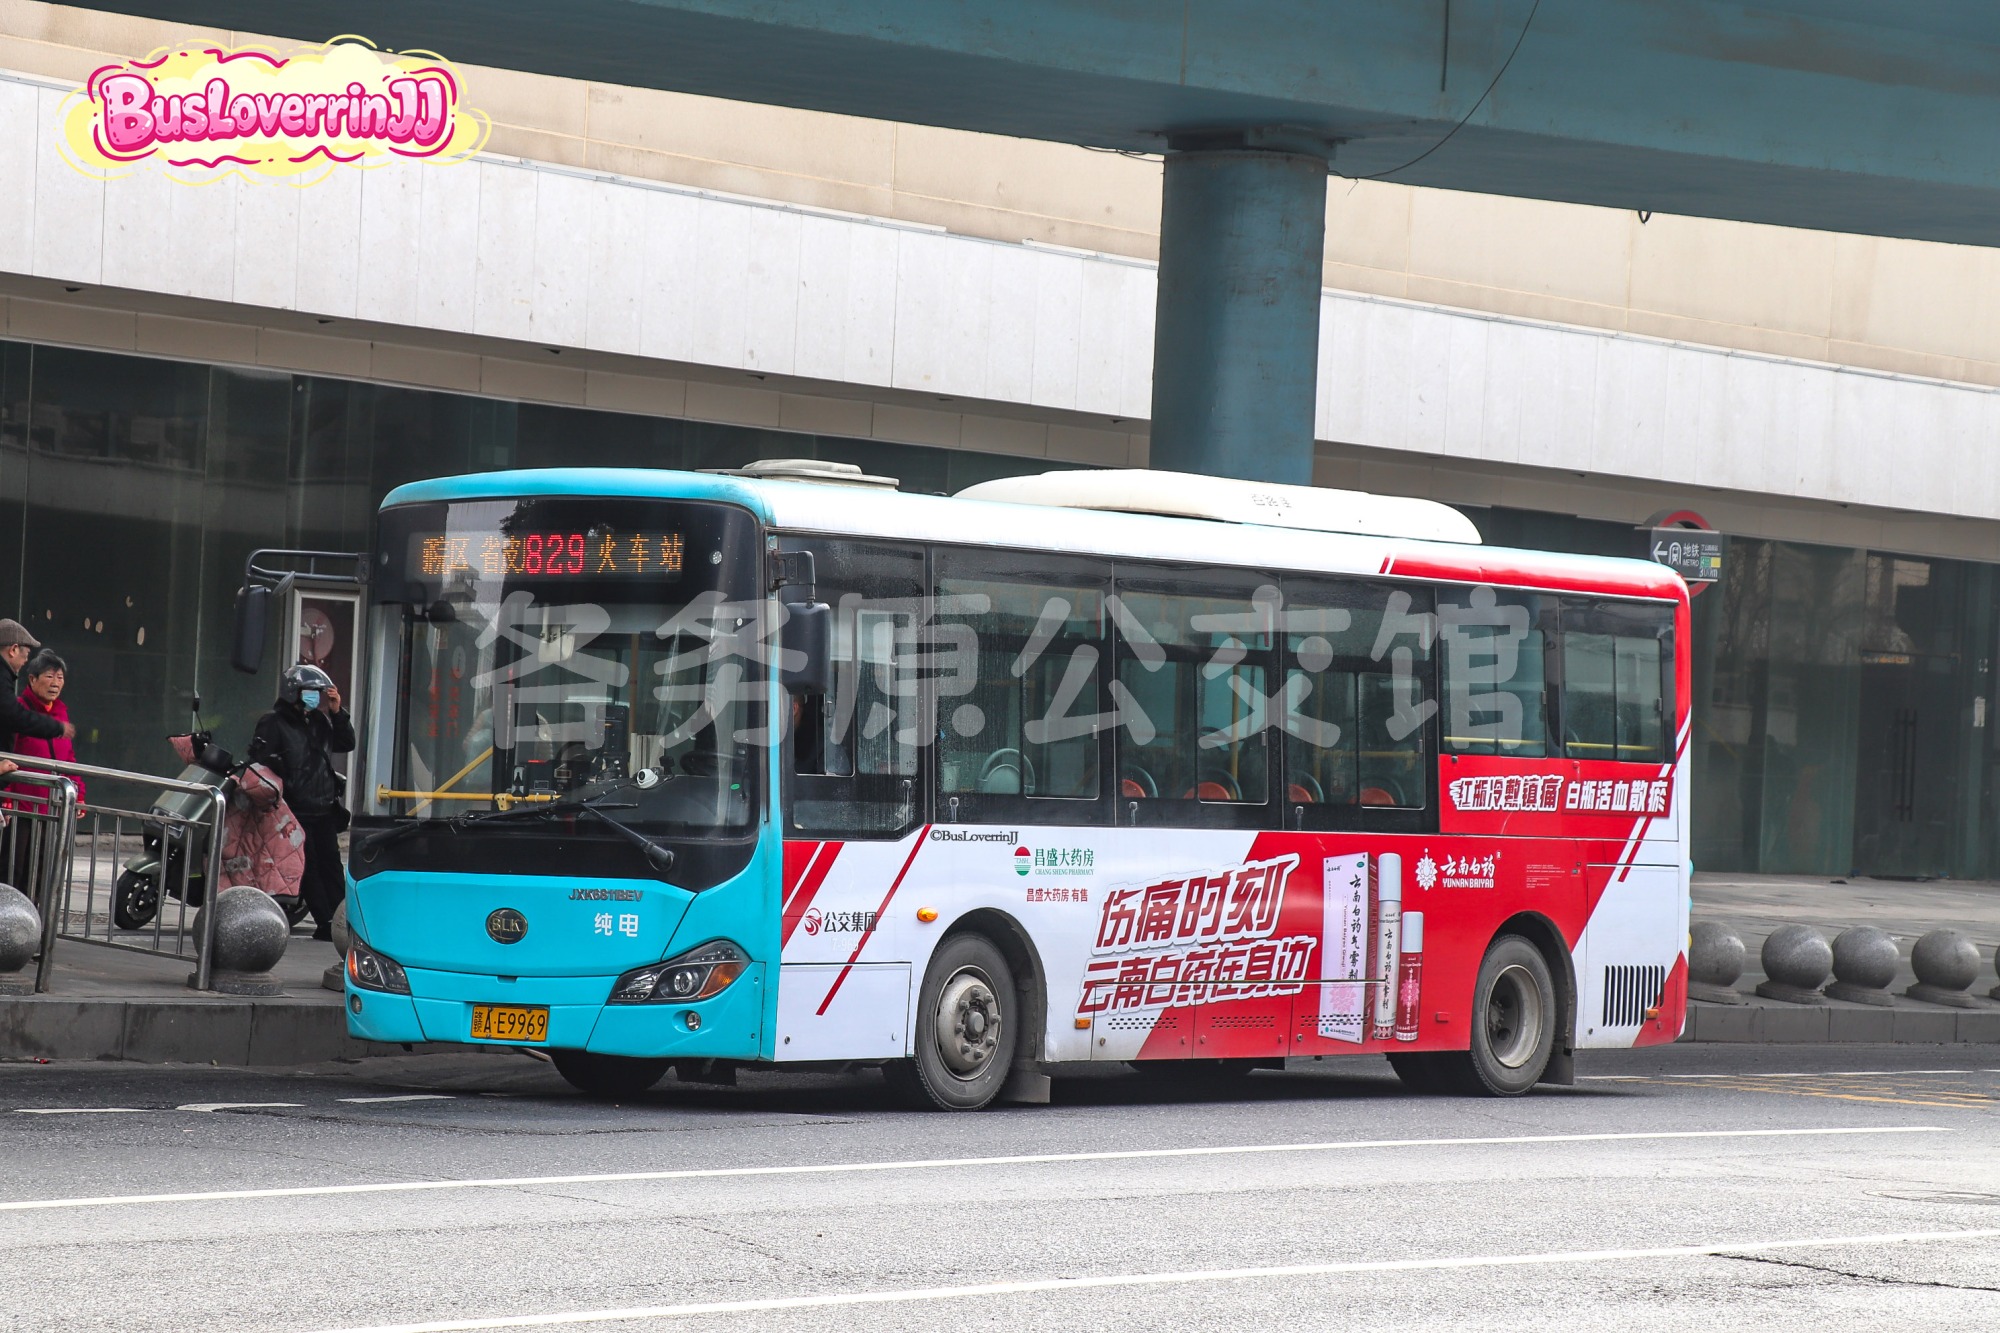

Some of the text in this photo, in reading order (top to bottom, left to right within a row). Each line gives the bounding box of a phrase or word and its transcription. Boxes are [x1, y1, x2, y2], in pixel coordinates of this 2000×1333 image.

[526, 534, 585, 574] 829
[598, 533, 683, 573] 火车站
[1683, 542, 1699, 557] 地铁
[1683, 559, 1700, 567] METRO
[1457, 775, 1668, 812] 红瓶冷敷镇痛 白瓶活血散瘀
[1035, 848, 1094, 867] 昌盛大药房
[1440, 854, 1495, 879] 云南白药
[1068, 868, 1094, 876] PHARMACY
[1442, 878, 1494, 889] YUNNAN BAIYAO
[1026, 888, 1088, 903] 昌盛大药房 有售
[1096, 860, 1296, 949] 伤痛时刻
[492, 918, 522, 933] BLK
[594, 912, 639, 938] 纯电
[824, 912, 877, 933] 公交集团
[1077, 941, 1310, 1014] 云南白药在身边
